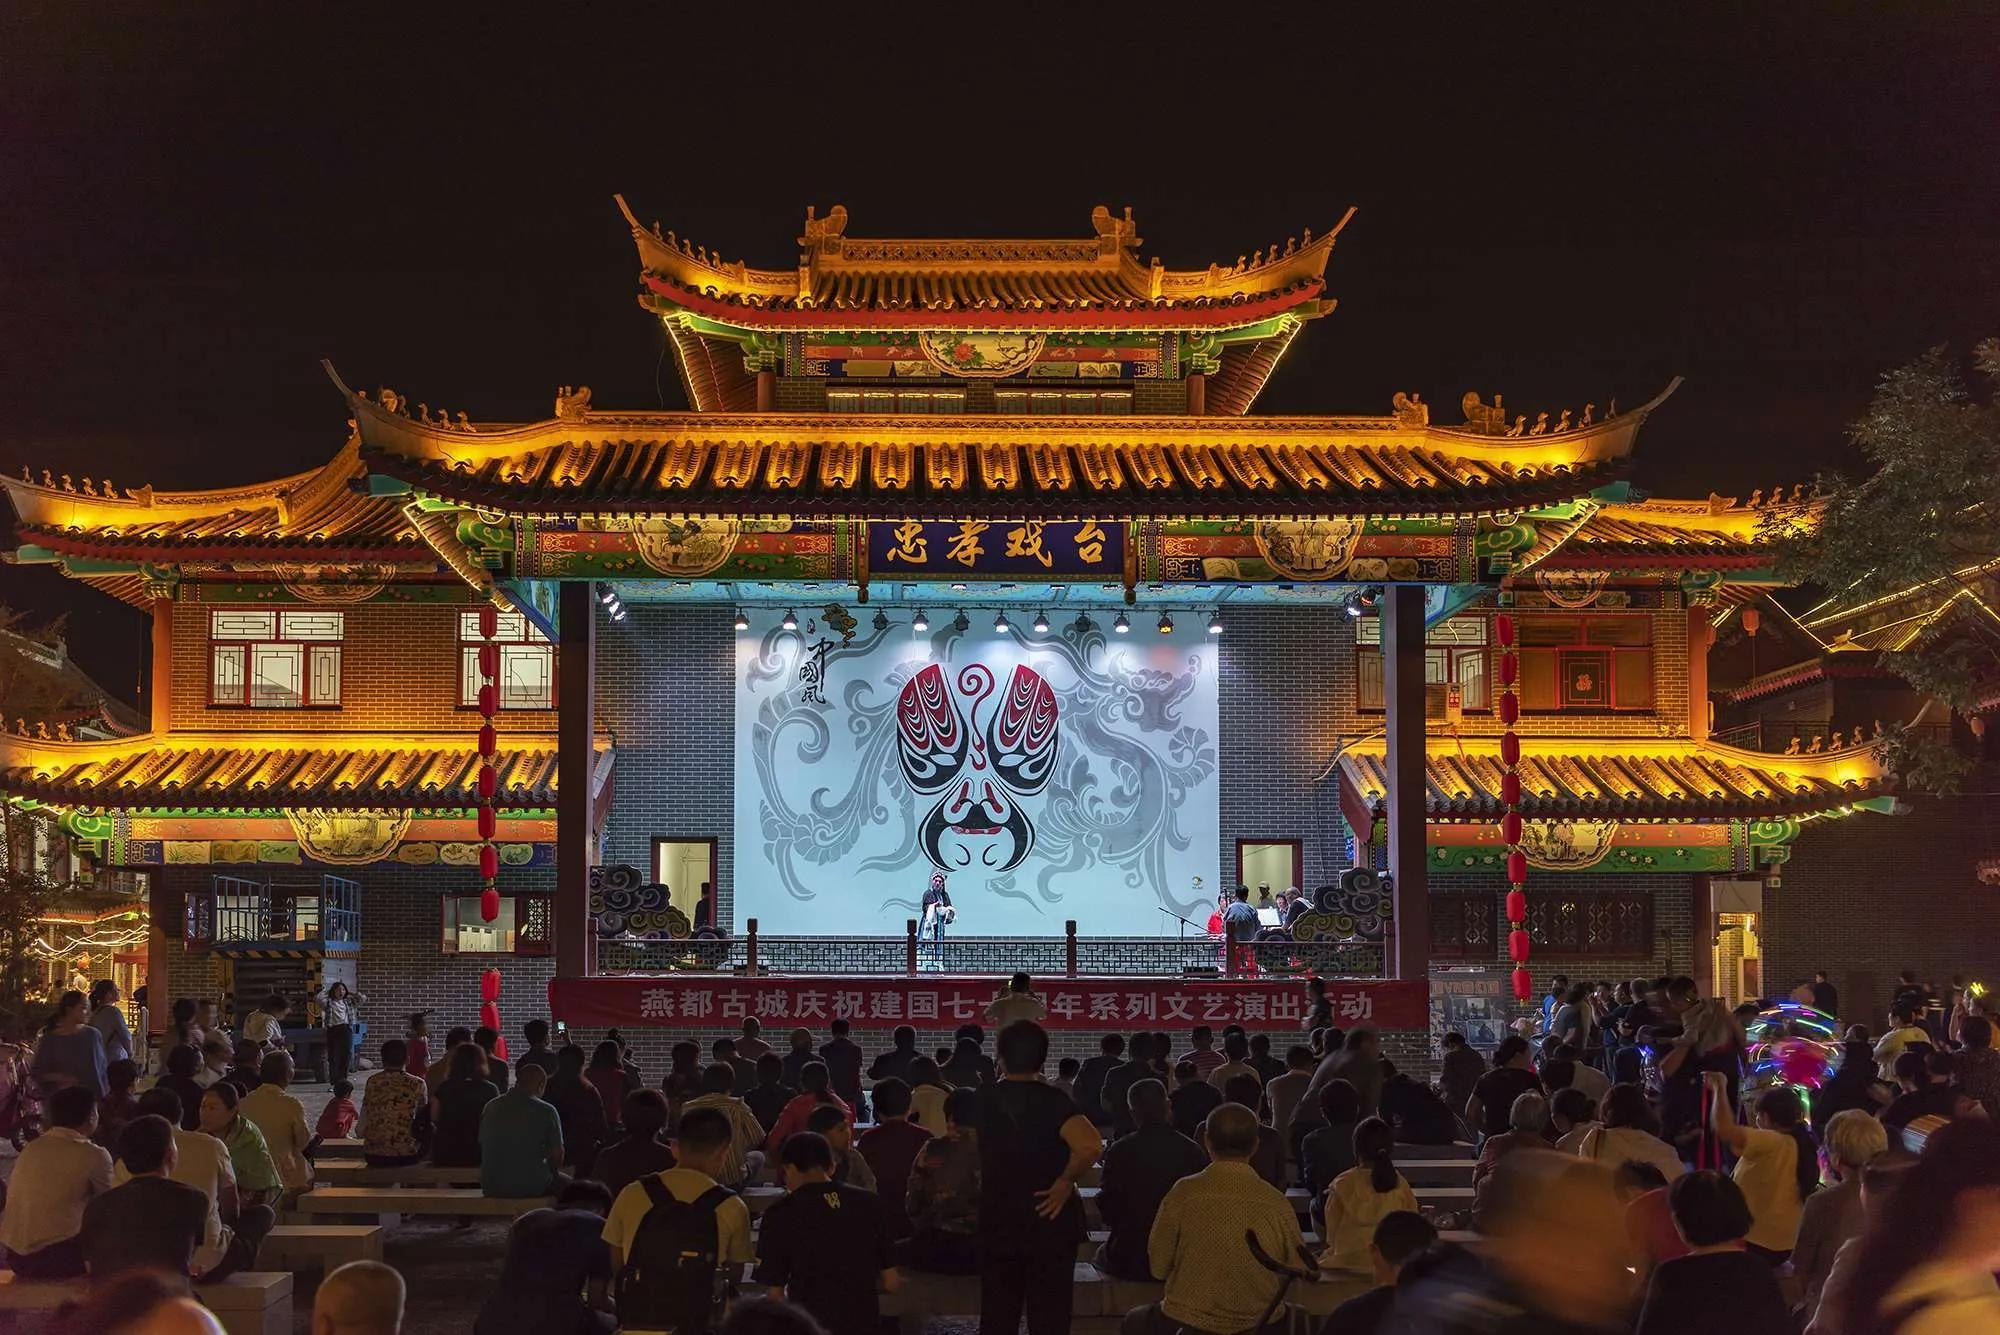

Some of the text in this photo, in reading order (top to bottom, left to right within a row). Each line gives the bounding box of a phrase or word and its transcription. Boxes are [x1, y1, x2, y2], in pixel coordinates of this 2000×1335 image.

[887, 521, 1106, 567] 忠孝戏台
[640, 988, 1373, 1020] 燕都古城庆祝建国七年系列文艺演出动
